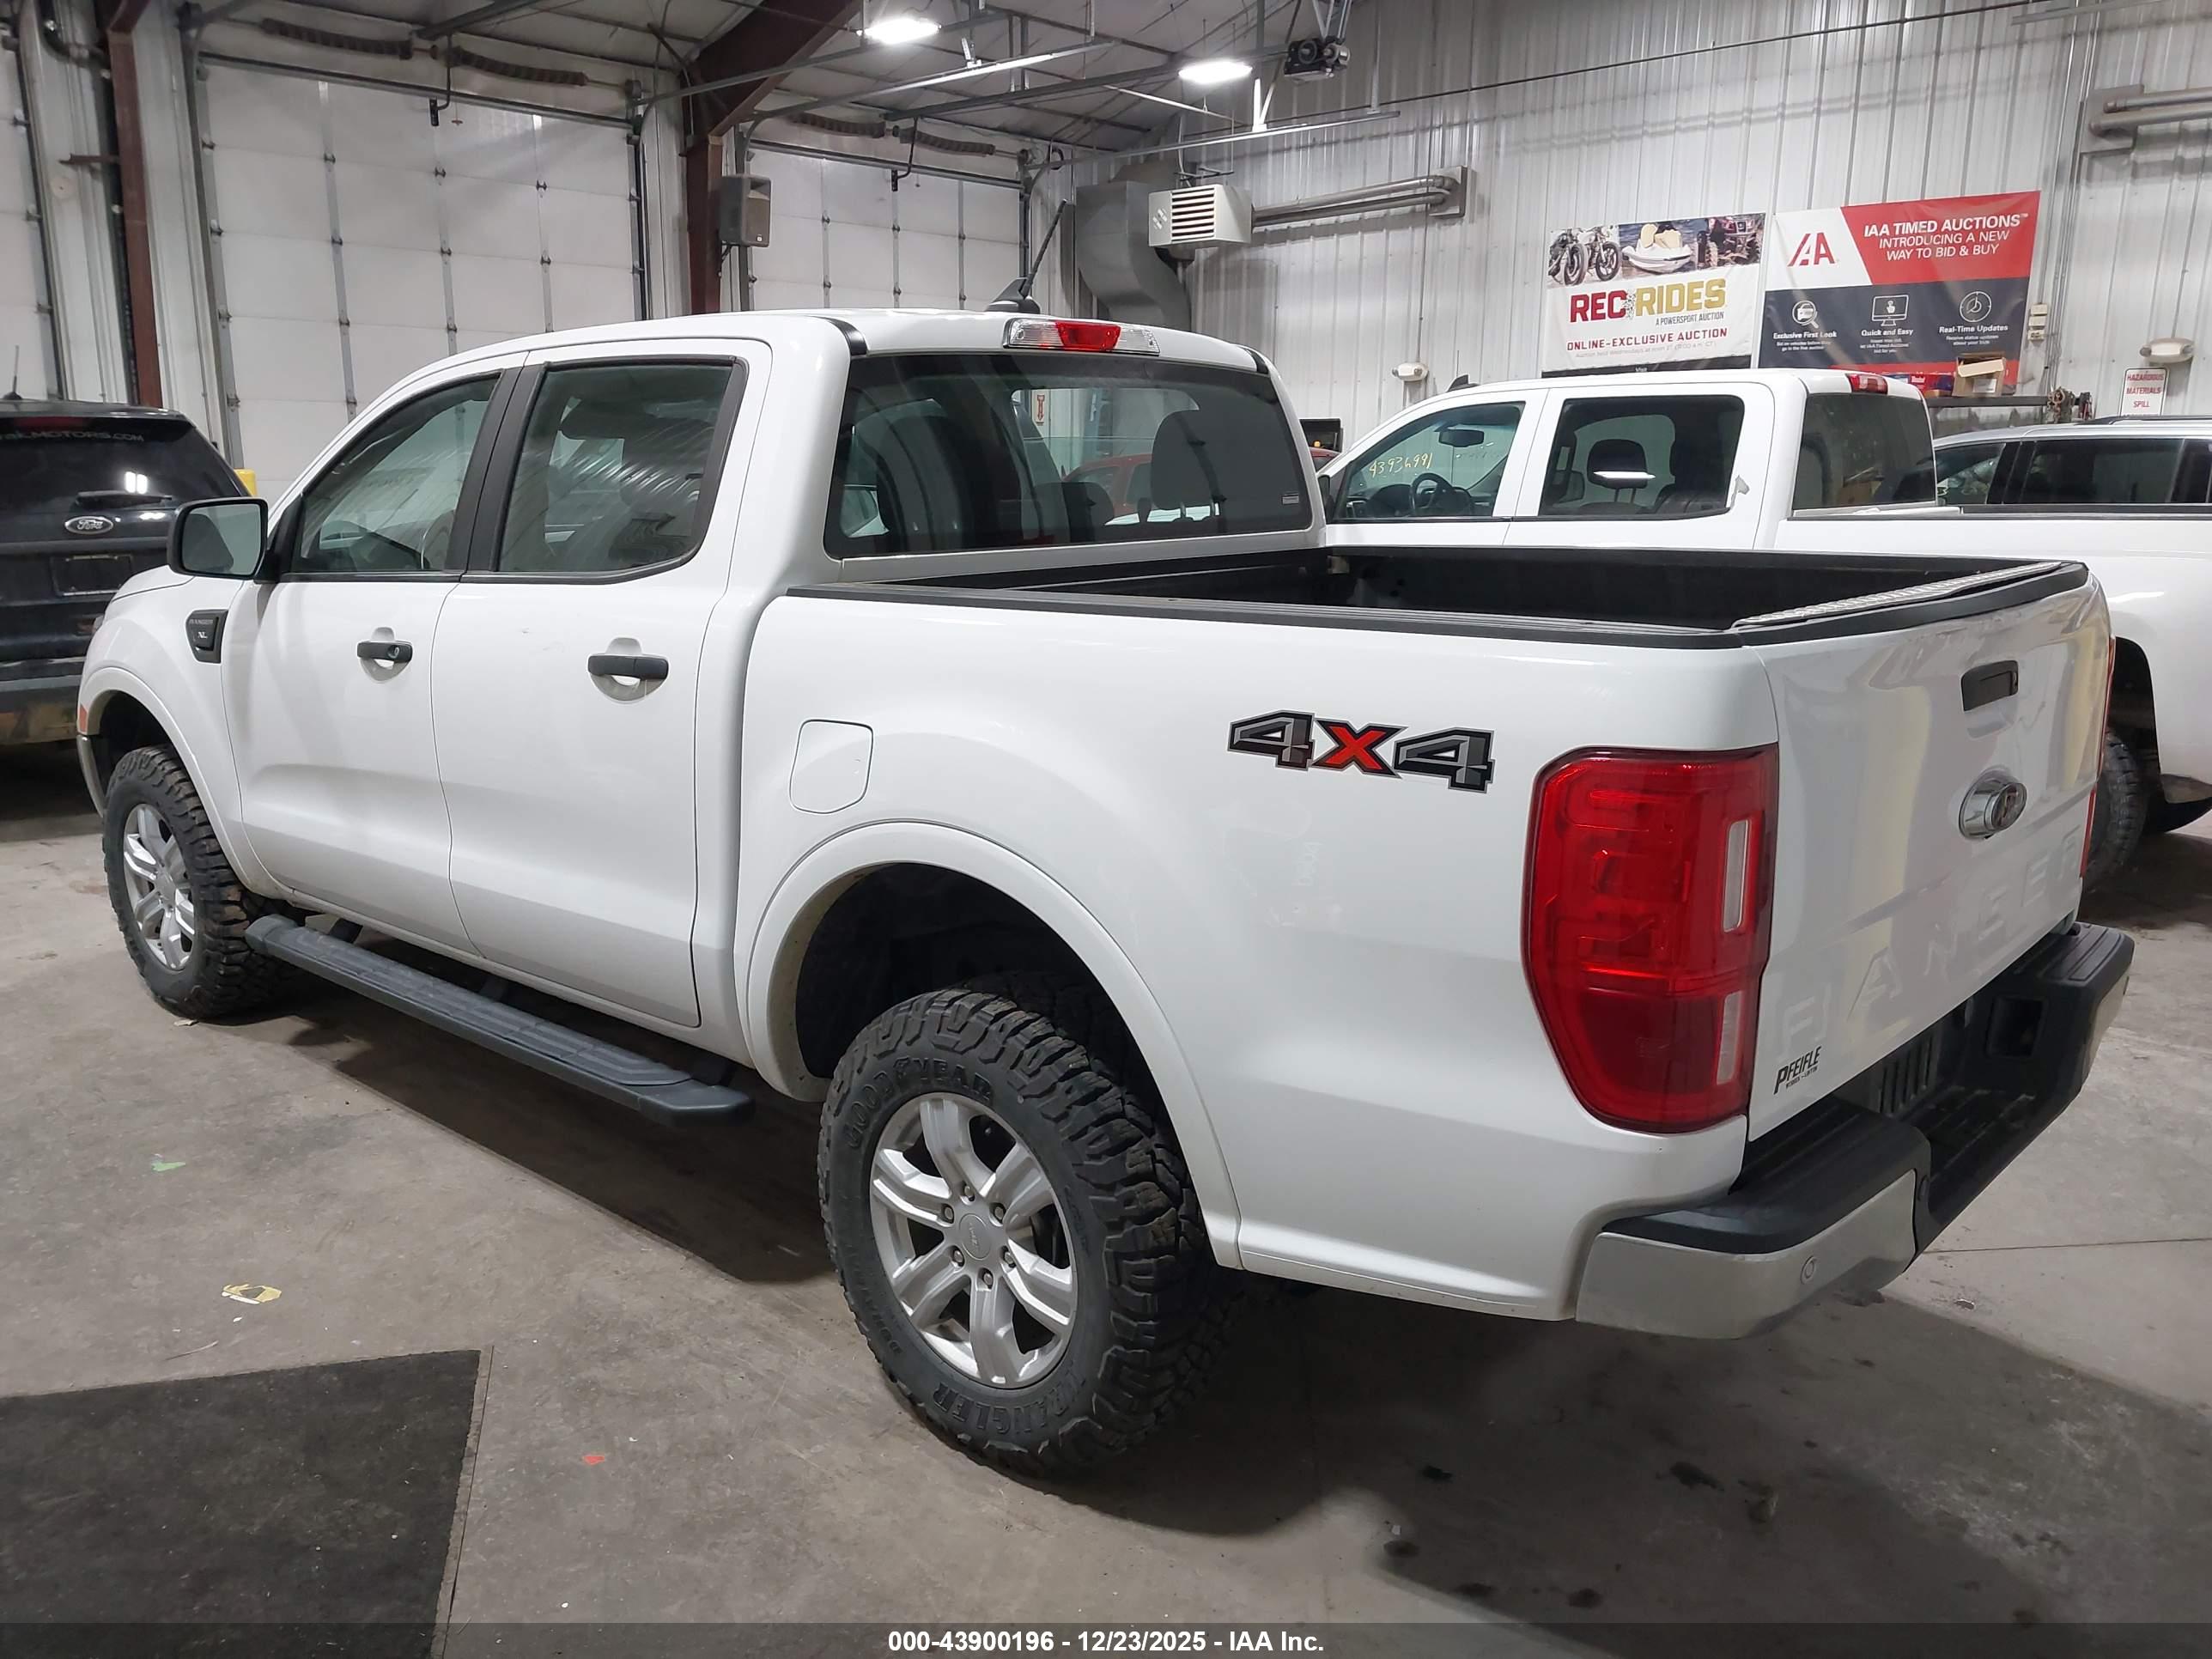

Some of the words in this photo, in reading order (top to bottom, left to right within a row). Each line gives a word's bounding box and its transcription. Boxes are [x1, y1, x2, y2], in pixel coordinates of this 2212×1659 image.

[1863, 224, 1890, 238] IAA
[1893, 220, 1937, 235] TIMED
[1879, 234, 1963, 249] INTRODUCING
[1966, 233, 1976, 243] A
[1978, 230, 2010, 243] NEW
[1886, 248, 1913, 261] WAY
[1915, 247, 1932, 258] TO
[1936, 246, 1957, 258] BID
[1959, 246, 1970, 256] &
[1972, 243, 2000, 256] BUY
[1570, 289, 1628, 323] REC
[1635, 278, 1726, 317] RIDES
[1661, 314, 1698, 326] POWERSPORT
[1698, 311, 1724, 323] AUCTION
[1977, 324, 2008, 333] Updates
[1566, 332, 1674, 351] ONLINE-EXCLUSIVE
[1677, 327, 1728, 341] AUCTION
[1773, 1045, 1822, 1095] PFEIFLE
